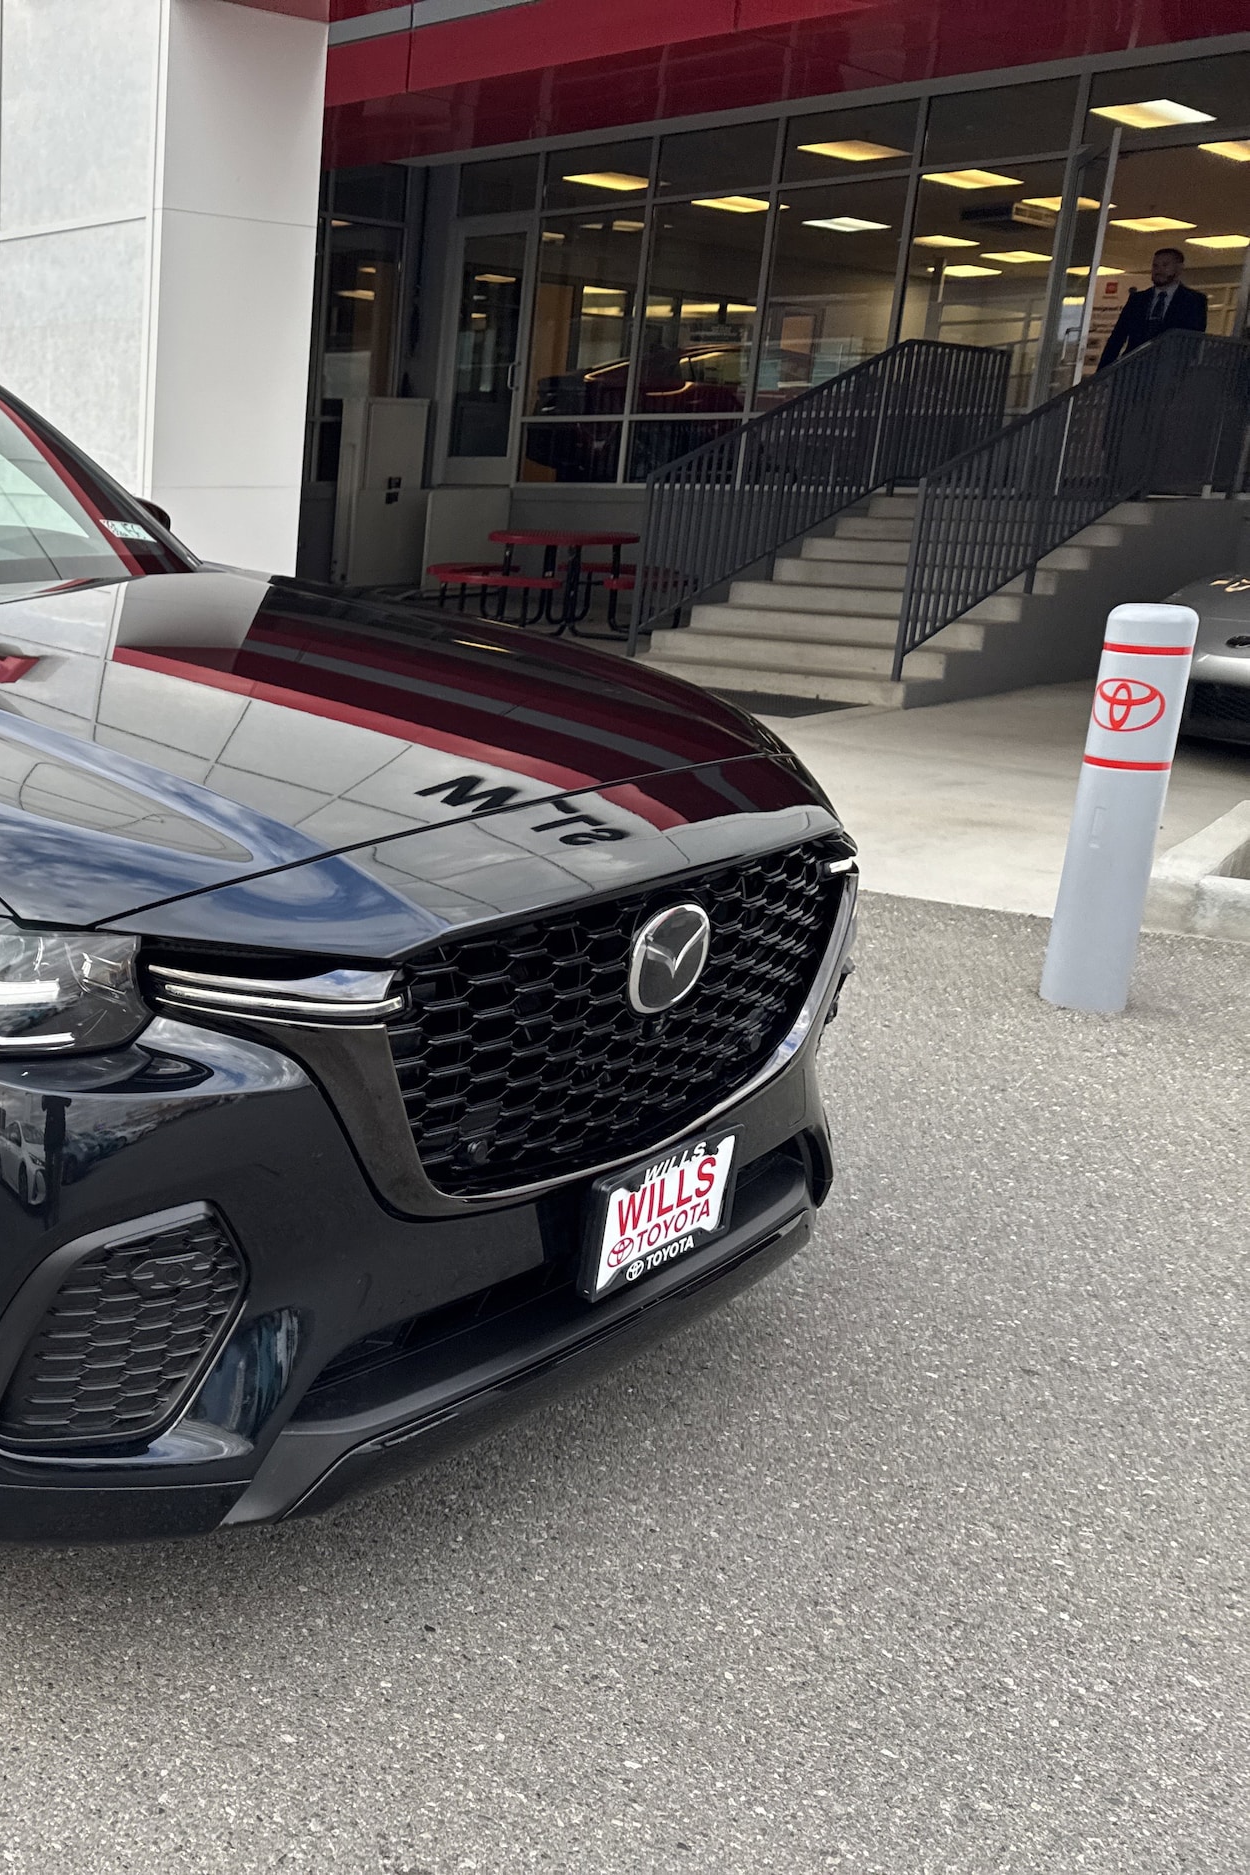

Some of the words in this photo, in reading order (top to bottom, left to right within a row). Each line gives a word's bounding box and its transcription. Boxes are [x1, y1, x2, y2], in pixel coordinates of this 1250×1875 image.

[644, 1141, 707, 1183] WILLS
[618, 1156, 717, 1237] WILLS
[637, 1199, 711, 1252] TOYOTA
[646, 1235, 695, 1270] TOYOTA
